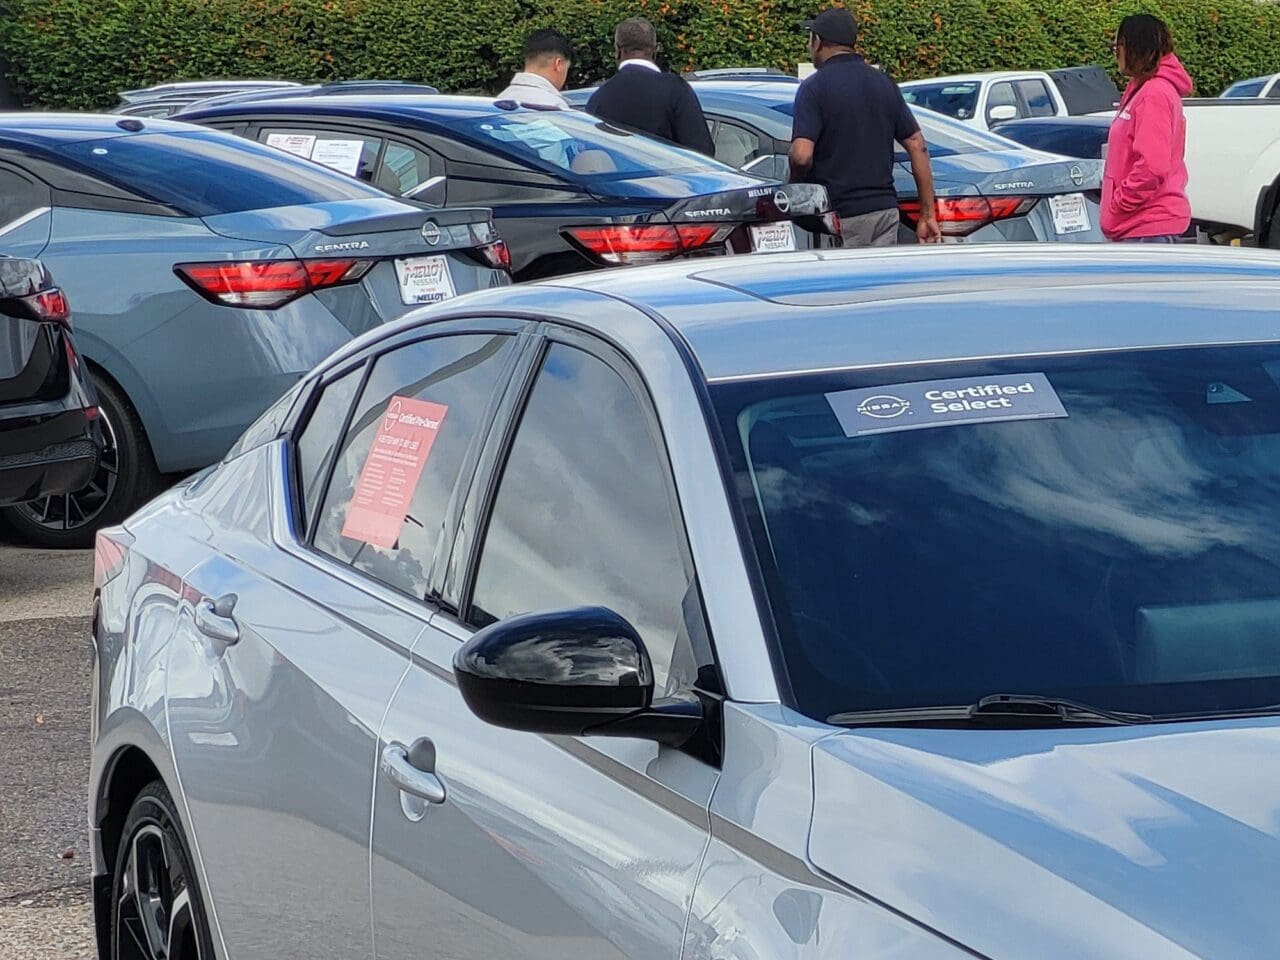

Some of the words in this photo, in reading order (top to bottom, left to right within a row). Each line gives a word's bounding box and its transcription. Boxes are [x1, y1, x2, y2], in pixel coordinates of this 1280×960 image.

[994, 181, 1034, 191] SENTRA
[684, 208, 731, 217] SENTRA
[314, 240, 369, 253] SENTRA
[403, 264, 443, 286] MELLOY
[413, 277, 439, 286] NISSAN
[924, 382, 1035, 401] Certified
[856, 401, 910, 412] NISSAN
[930, 397, 1013, 413] Select
